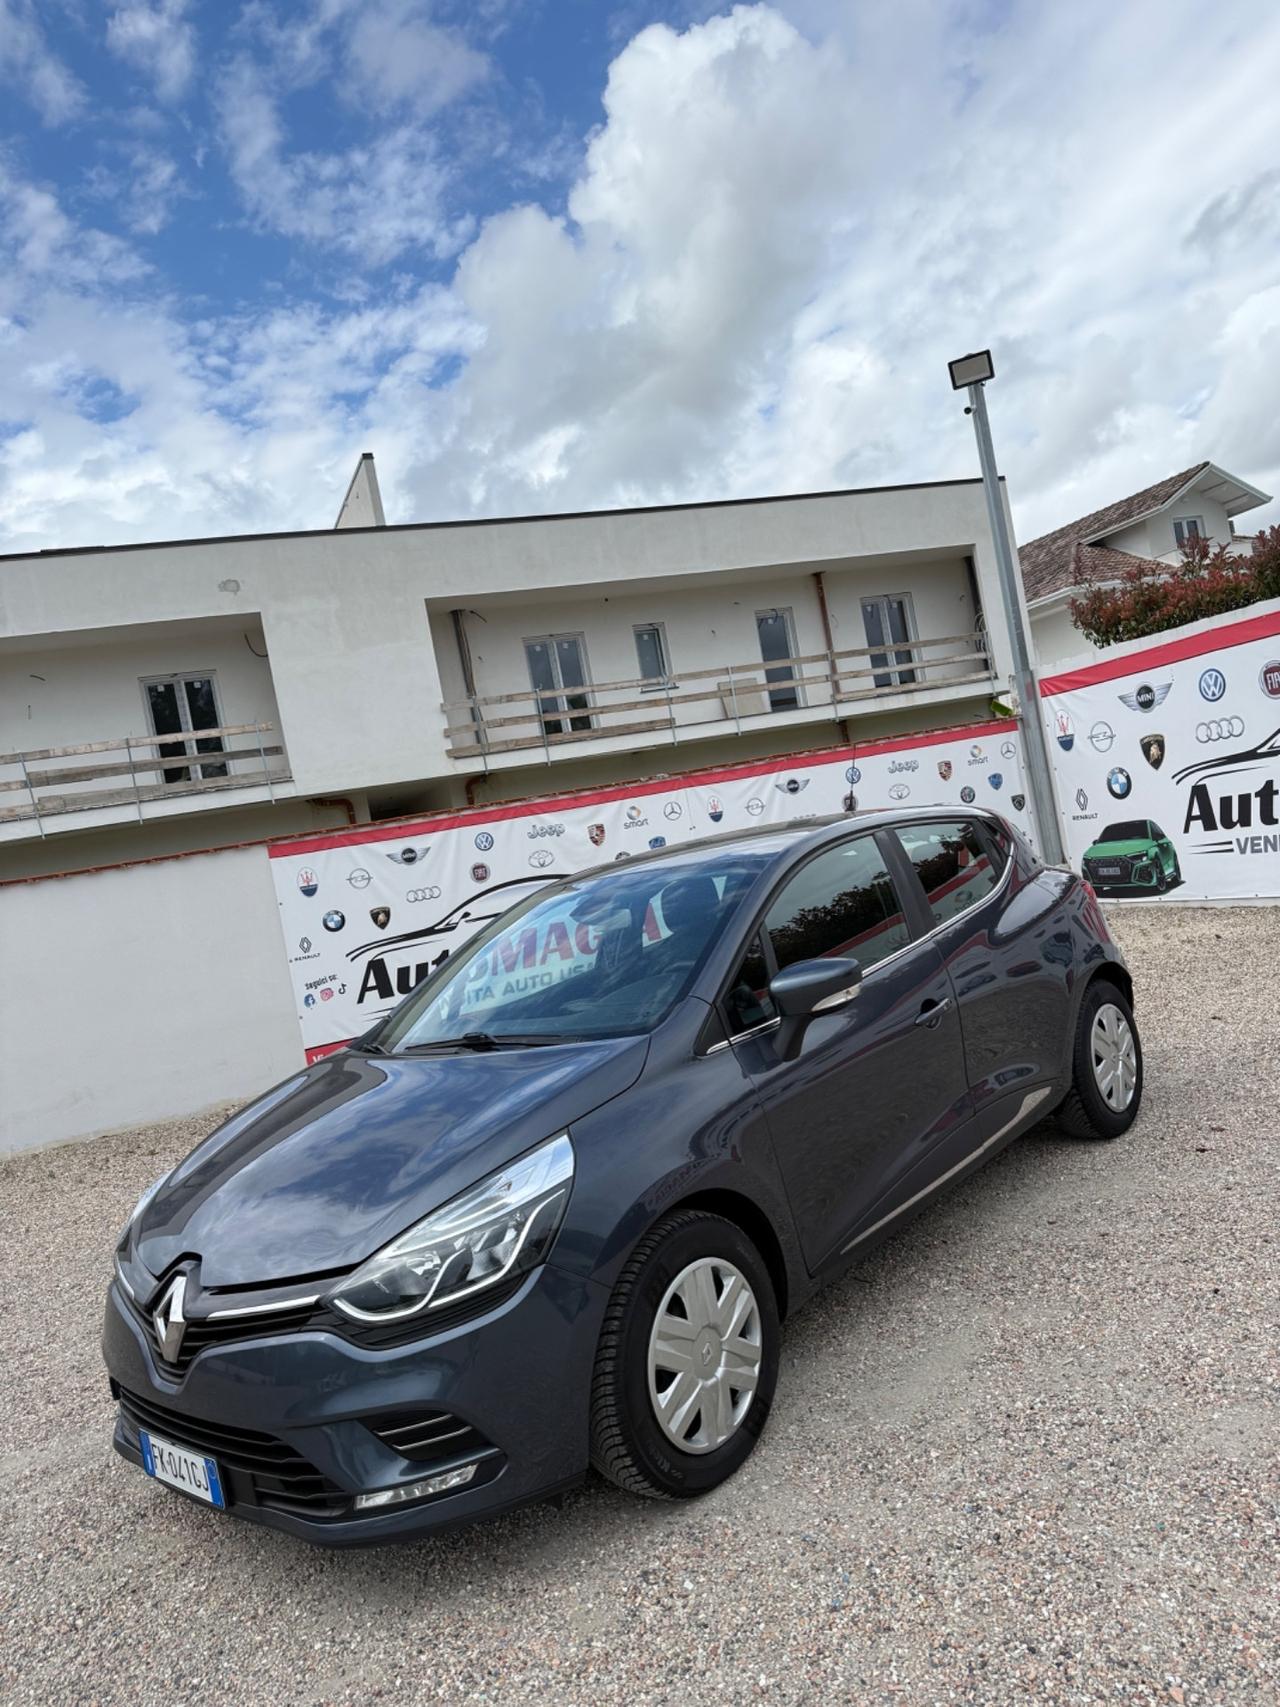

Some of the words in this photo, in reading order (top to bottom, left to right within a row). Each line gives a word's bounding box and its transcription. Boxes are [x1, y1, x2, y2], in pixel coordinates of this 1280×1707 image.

[1137, 691, 1155, 704] MINI
[968, 757, 989, 766] smart
[1072, 812, 1098, 820] RENAULT
[623, 818, 649, 830] smart
[527, 823, 566, 839] Jeep
[1235, 834, 1280, 855] VEN
[503, 969, 553, 996] AUTO
